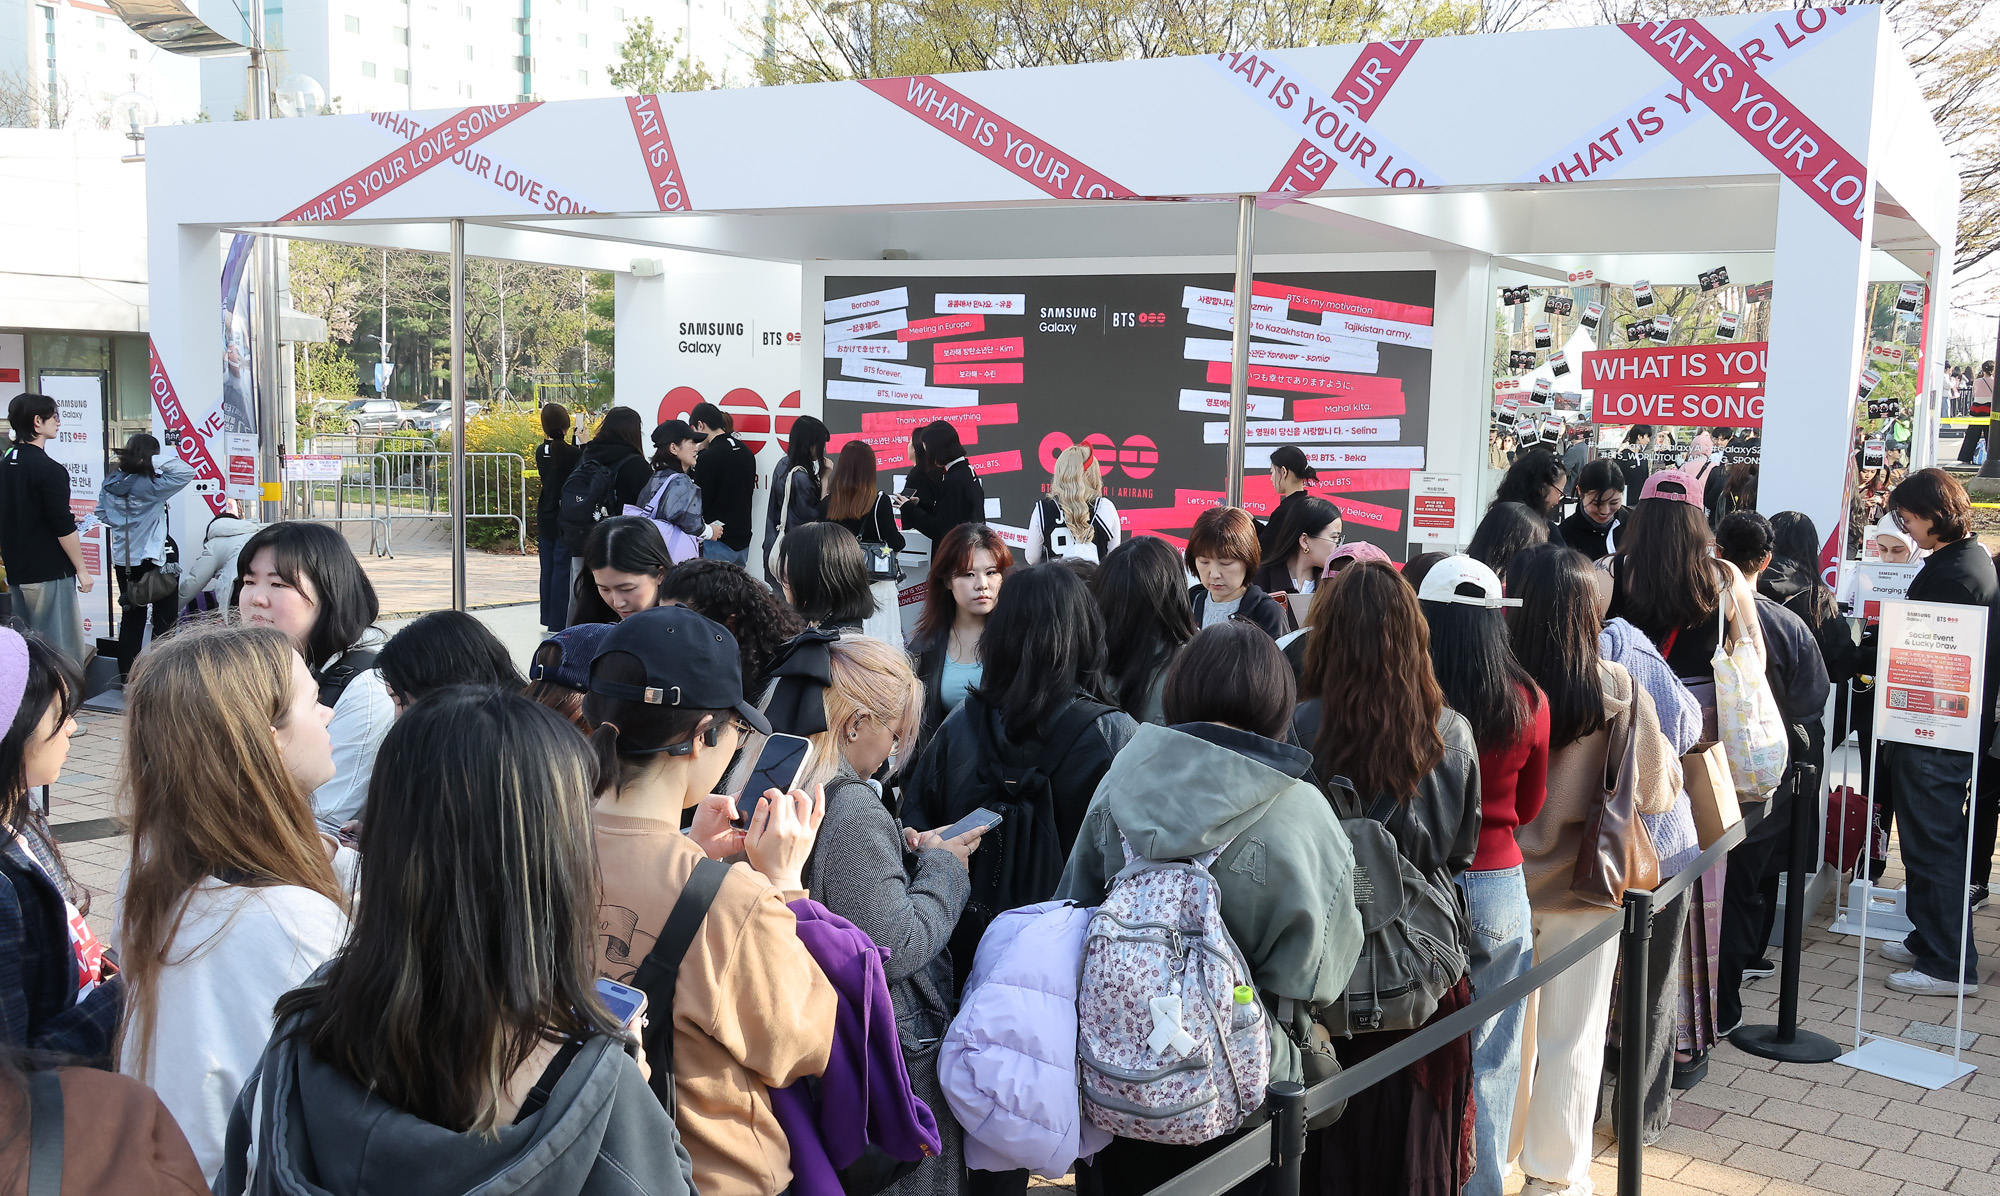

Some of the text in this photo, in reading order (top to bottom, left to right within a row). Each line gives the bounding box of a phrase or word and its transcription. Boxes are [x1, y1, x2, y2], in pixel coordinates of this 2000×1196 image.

[1692, 54, 1733, 93] IS
[1730, 81, 1819, 171] YOUR
[1268, 75, 1300, 109] IS
[1302, 96, 1377, 169] YOUR
[1375, 155, 1425, 188] LO
[1626, 106, 1664, 144] IS
[906, 77, 1115, 199] WHAT IS YOUR LO
[339, 185, 358, 210] IS
[357, 156, 408, 197] YOUR
[408, 128, 456, 169] LOVE
[1295, 146, 1329, 182] IS
[451, 149, 491, 179] OUR
[494, 164, 543, 204] LOVE
[543, 189, 598, 214] SON
[647, 139, 669, 168] IS
[659, 168, 685, 211] YO
[851, 300, 880, 310] Borahae
[1286, 294, 1373, 314] BTS is my motivation
[1040, 307, 1097, 318] SAMSUNG
[1112, 312, 1135, 327] BTS
[679, 322, 744, 336] SAMSUNG
[908, 320, 972, 335] Meeting in Europe.
[1039, 322, 1077, 335] Galaxy
[1255, 322, 1264, 330] to
[1265, 324, 1315, 340] Kazakhstan
[1316, 333, 1333, 343] too.
[1344, 321, 1412, 341] Tajikistan army.
[762, 332, 782, 346] BTS
[678, 341, 721, 357] Galaxy
[943, 348, 962, 357] 보라해
[864, 366, 902, 379] BTS forever.
[1590, 354, 1674, 381] WHAT
[1681, 353, 1707, 378] IS
[959, 370, 978, 378] 보라해
[150, 363, 180, 426] YOUR
[894, 391, 909, 399] love
[57, 400, 88, 409] SAMSUNG
[1324, 402, 1372, 413] Mahal kita.
[1602, 393, 1765, 419] LOVE SONG
[62, 410, 83, 420] Galaxy
[896, 417, 917, 425] Thank
[917, 417, 931, 425] you
[943, 413, 981, 422] everything
[60, 431, 72, 443] BTS
[1256, 427, 1277, 437] 영원히
[1351, 427, 1377, 435] Selina
[888, 456, 904, 464] nabi
[1344, 454, 1367, 462] Beka
[81, 463, 88, 474] 내
[1319, 481, 1335, 489] you
[1336, 478, 1351, 486] BTS
[1117, 487, 1154, 499] ARIRANG
[1187, 497, 1205, 505] Let's
[1346, 507, 1384, 522] beloved.
[1872, 586, 1902, 595] Charging
[1908, 632, 1954, 642] Social Event
[1911, 640, 1934, 649] Lucky
[1935, 642, 1957, 650] Draw
